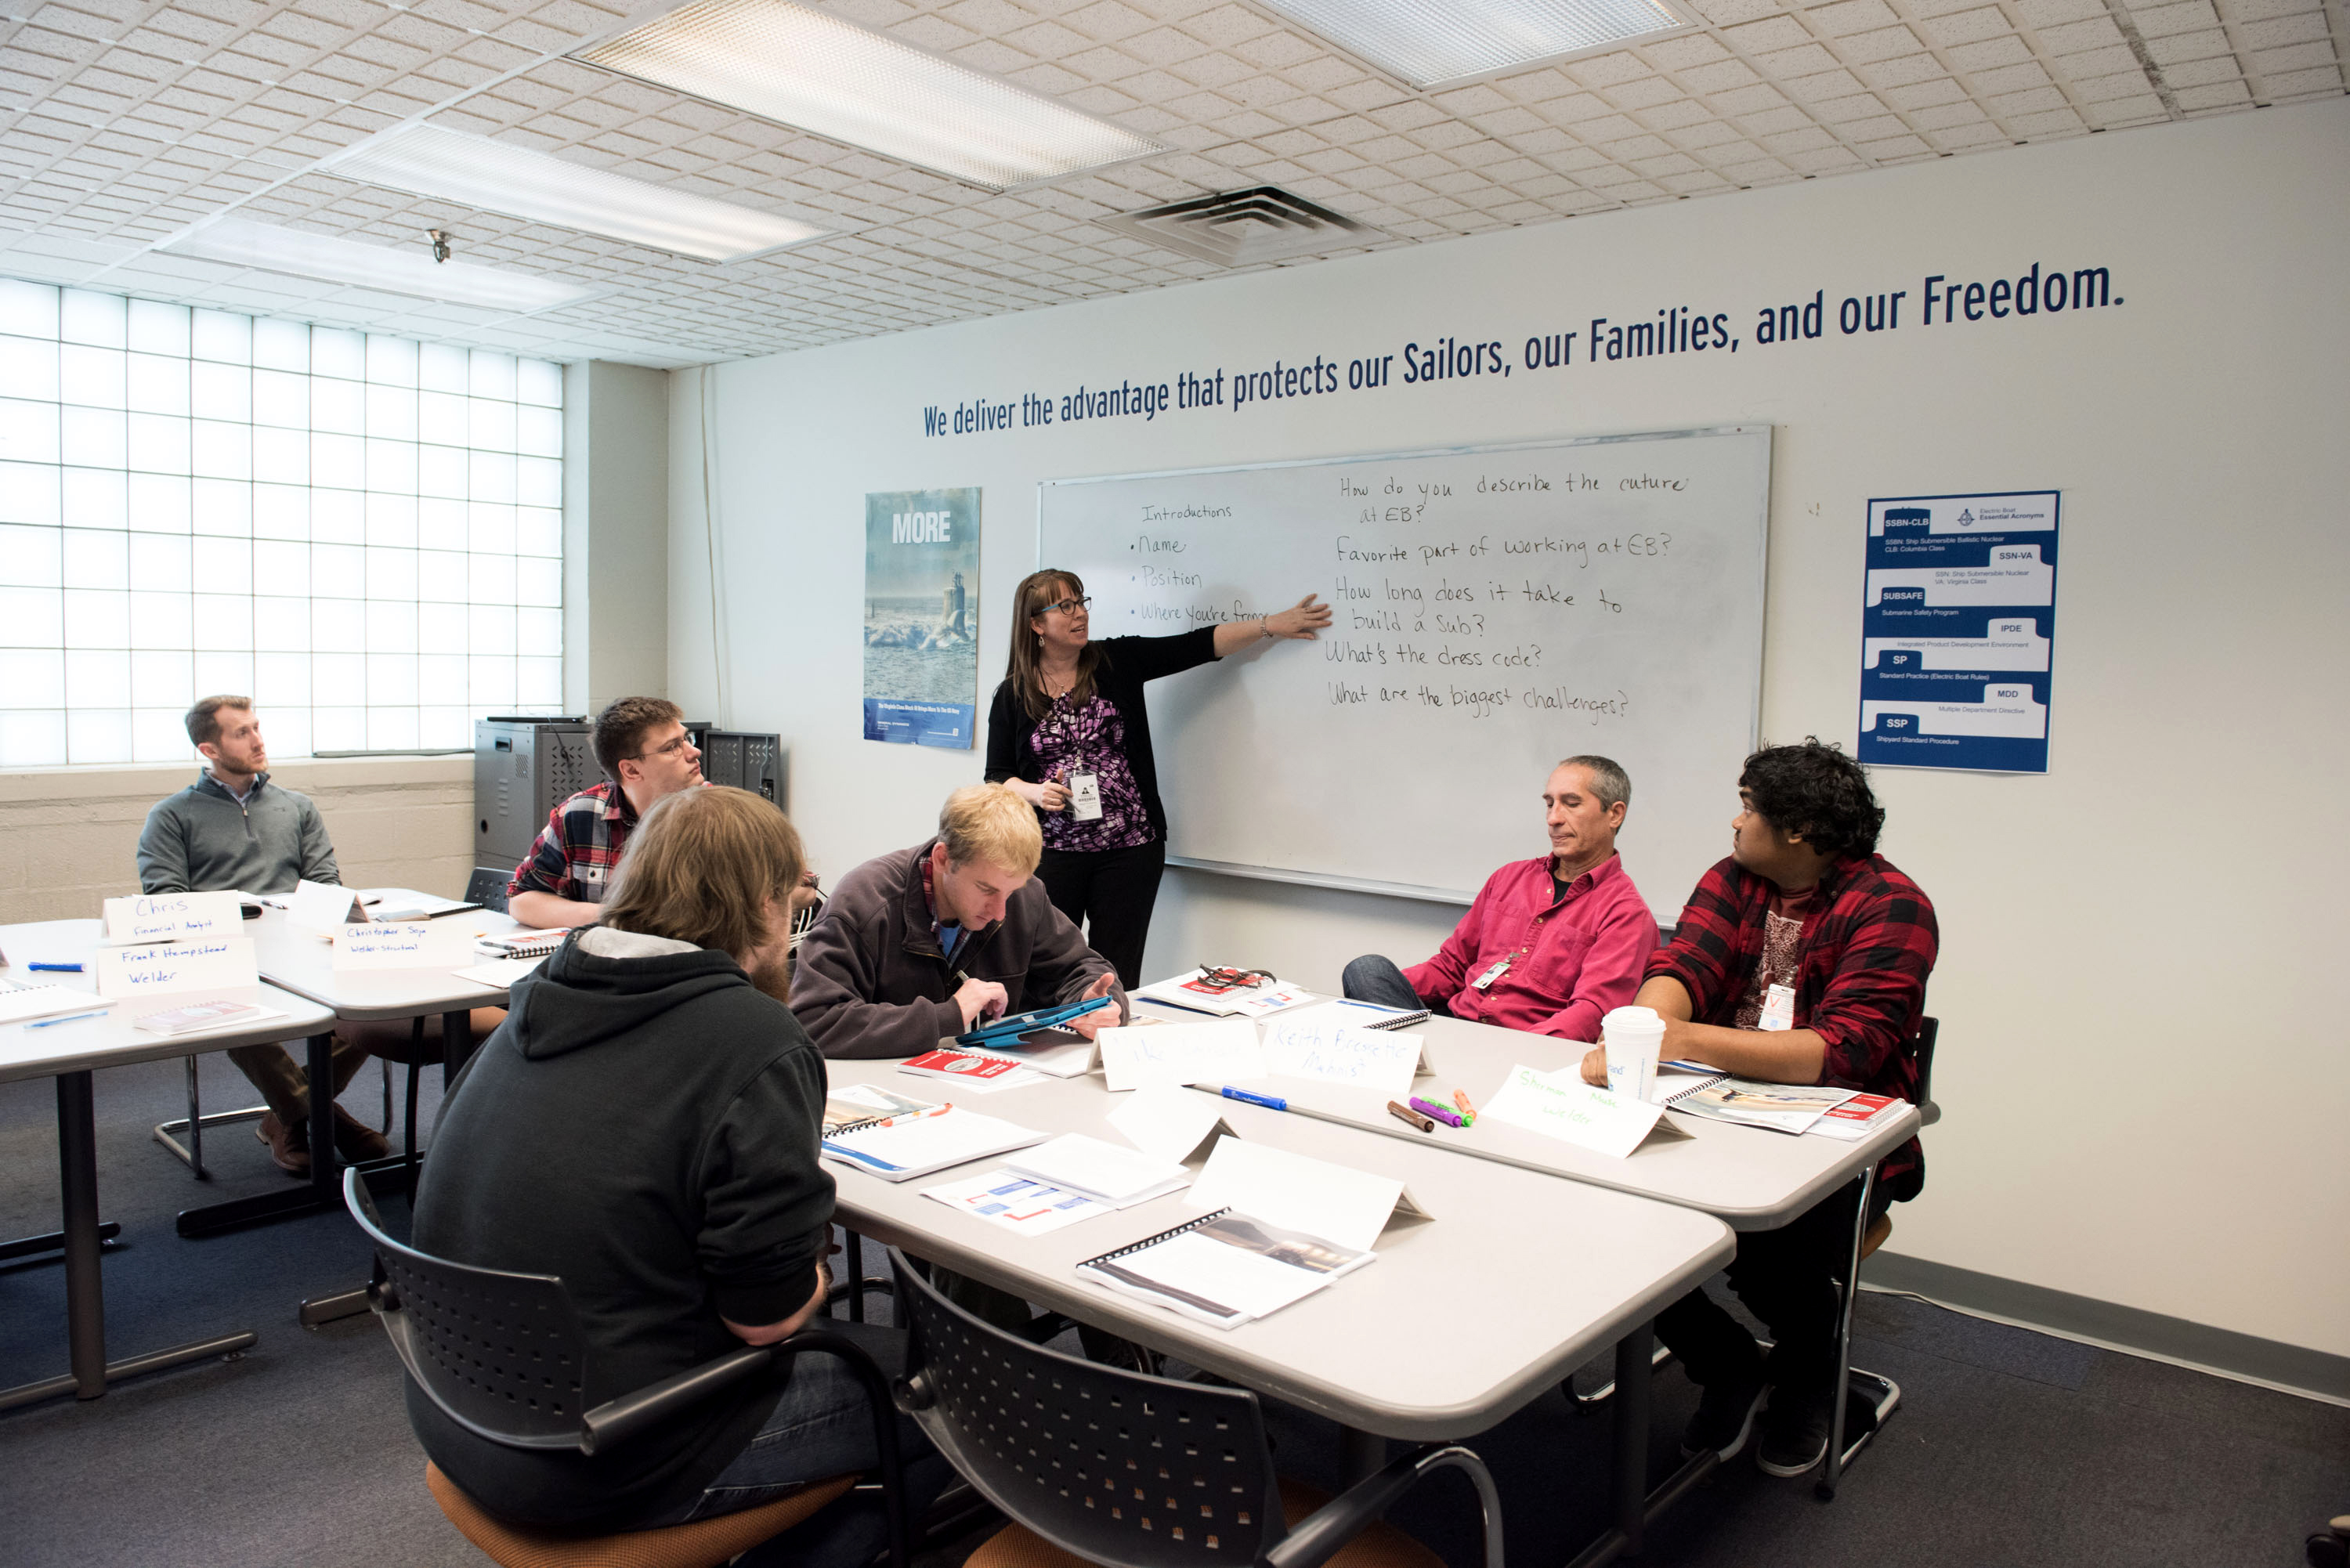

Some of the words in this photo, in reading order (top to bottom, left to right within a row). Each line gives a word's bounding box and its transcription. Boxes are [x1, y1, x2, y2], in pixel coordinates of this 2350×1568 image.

[924, 405, 947, 438] We
[953, 399, 1016, 435] deliver
[1022, 393, 1053, 427] the
[1061, 379, 1169, 422] advantage
[1177, 368, 1224, 410] that
[1234, 355, 1337, 411] protects
[1349, 355, 1393, 390] our
[1404, 338, 1512, 384] Sailors,
[1524, 329, 1576, 370] our
[1589, 307, 1740, 363] Families,
[1756, 290, 1823, 345] and
[1840, 291, 1906, 335] our
[1923, 262, 2125, 327] Freedom.
[1340, 477, 1368, 496] How
[1384, 477, 1403, 494] do
[1419, 483, 1452, 505] you
[1477, 474, 1551, 493] describe
[1565, 474, 1600, 492] the
[1142, 504, 1232, 522] Introductions
[1360, 504, 1377, 522] at
[1386, 504, 1425, 522] EB?
[1885, 518, 1929, 527] SSBN-CLB
[892, 511, 951, 544] MORE
[1336, 536, 1408, 562] Favorite
[1423, 545, 1459, 565] part
[1470, 536, 1488, 556] of
[1504, 535, 1588, 569] working
[1597, 538, 1622, 553] at
[1627, 533, 1672, 555] EB?
[1141, 565, 1202, 588] Position
[1336, 576, 1371, 602] How
[1386, 578, 1424, 616] long
[1435, 577, 1473, 602] does
[1490, 580, 1512, 602] it
[1523, 580, 1575, 606] take
[1600, 589, 1622, 613] to
[1141, 602, 1181, 621] Where
[1353, 609, 1401, 631] build
[1414, 620, 1426, 632] a
[1325, 641, 1386, 665] What's
[1396, 643, 1429, 664] the
[1438, 645, 1483, 667] dress
[1492, 644, 1542, 668] code?
[1893, 656, 1907, 664] SP
[1328, 682, 1368, 705] What
[1380, 688, 1409, 701] are
[1417, 684, 1442, 707] the
[1451, 685, 1512, 717] biggest
[1524, 686, 1629, 725] challenges?
[1886, 719, 1908, 728] SSP
[136, 899, 188, 916] Chris
[347, 928, 398, 938] Christopher
[122, 950, 156, 963] Frank
[128, 970, 177, 984] Welder
[1276, 1024, 1321, 1046] Keith
